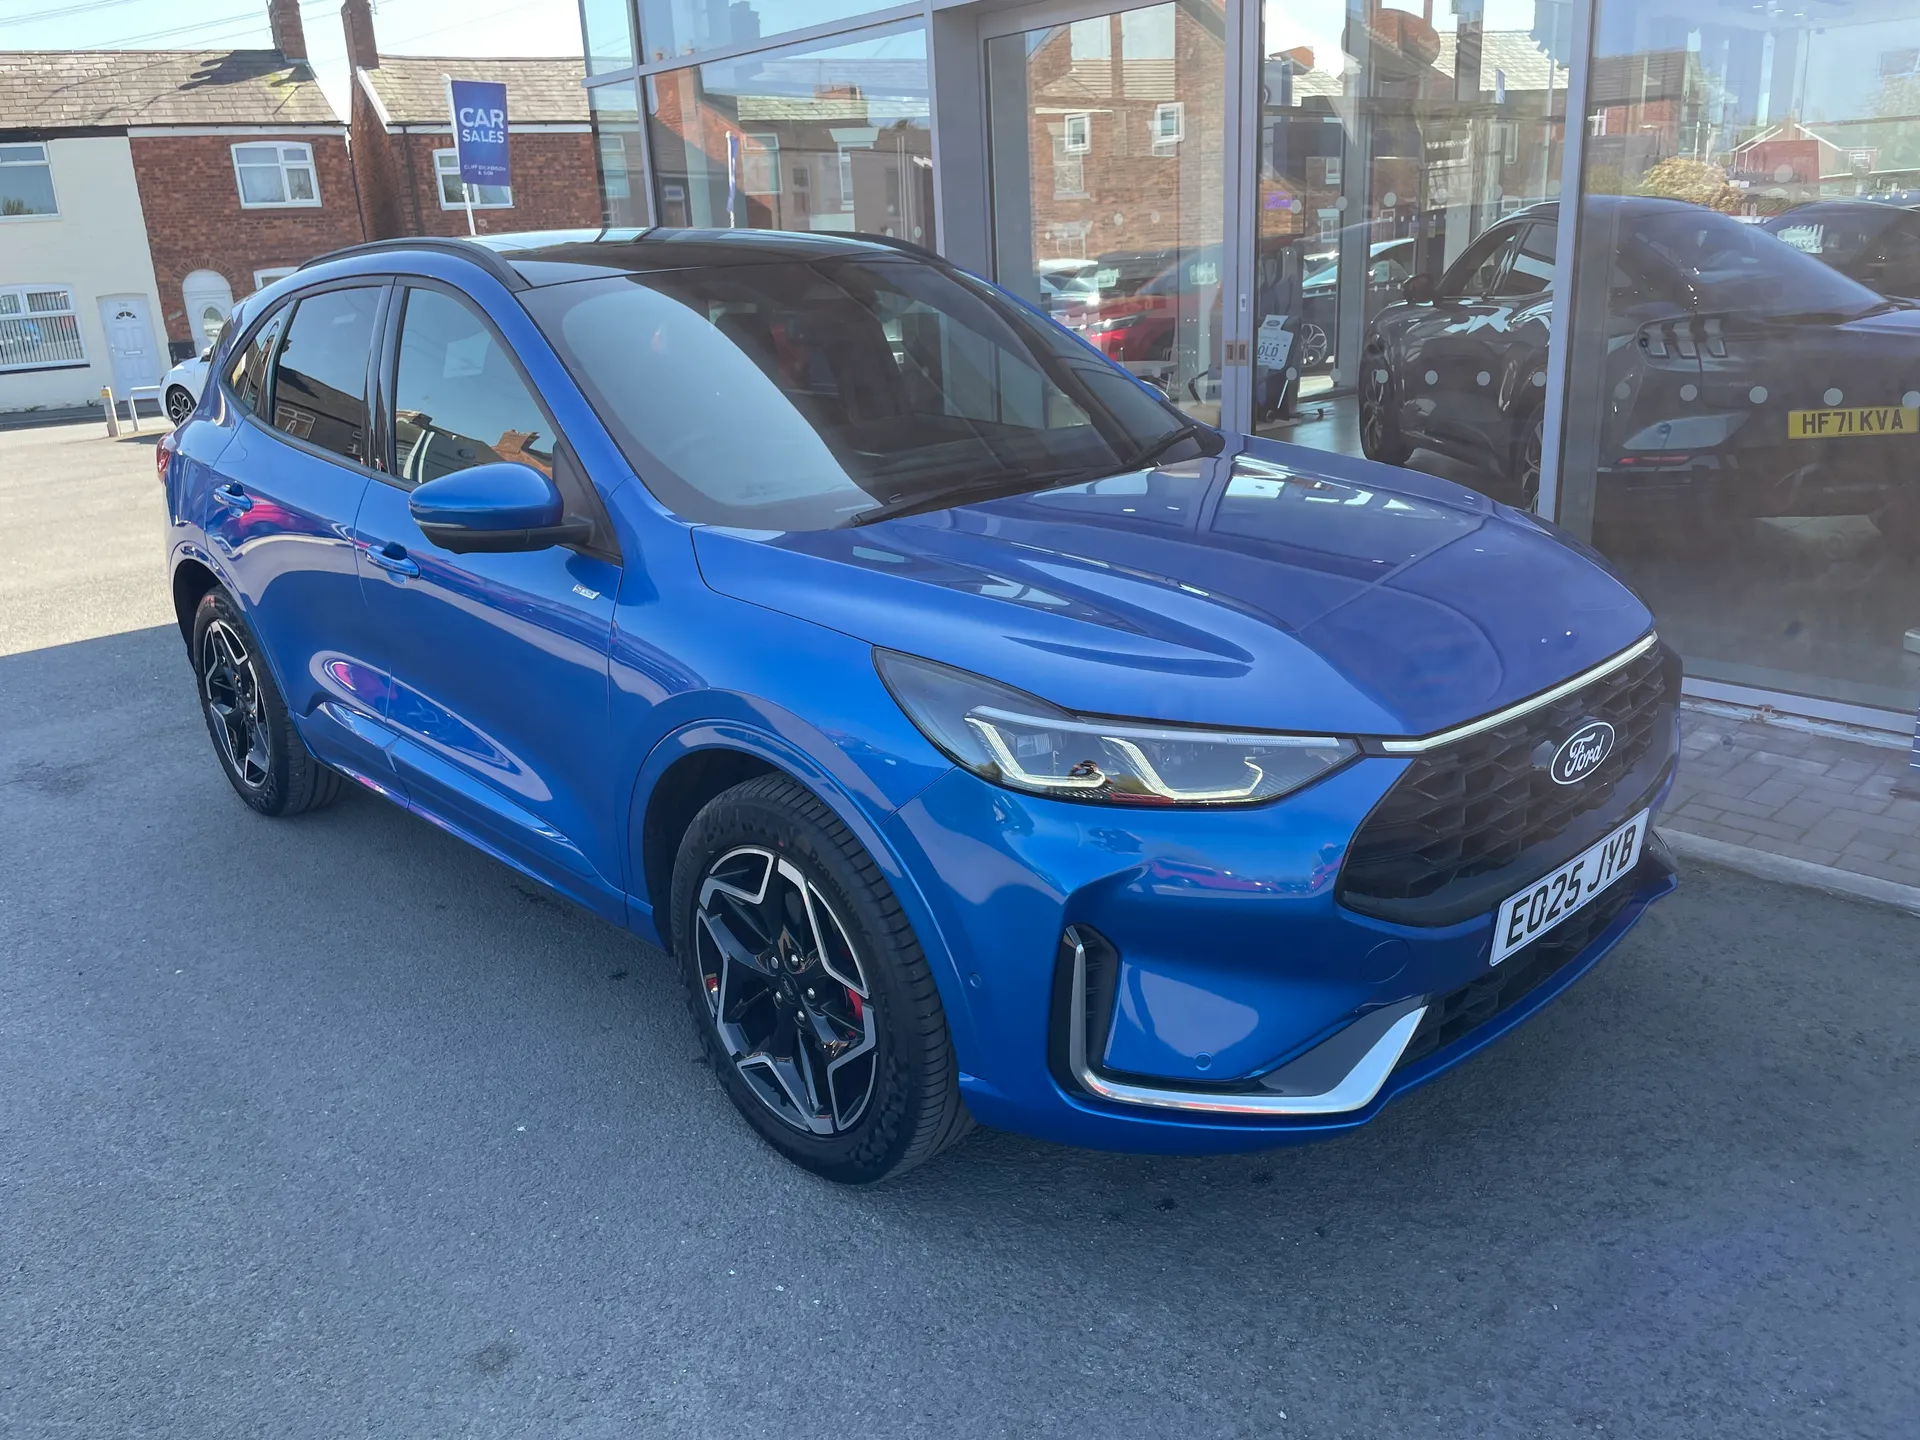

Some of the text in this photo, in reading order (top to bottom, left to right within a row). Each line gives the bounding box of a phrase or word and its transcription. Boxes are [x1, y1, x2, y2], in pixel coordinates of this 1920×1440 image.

[460, 107, 504, 129] CAR
[462, 129, 504, 144] SALES
[1258, 345, 1279, 358] OLD
[1802, 409, 1903, 434] HF71 KVA
[1564, 732, 1604, 778] Ford
[1587, 824, 1636, 893] JYB
